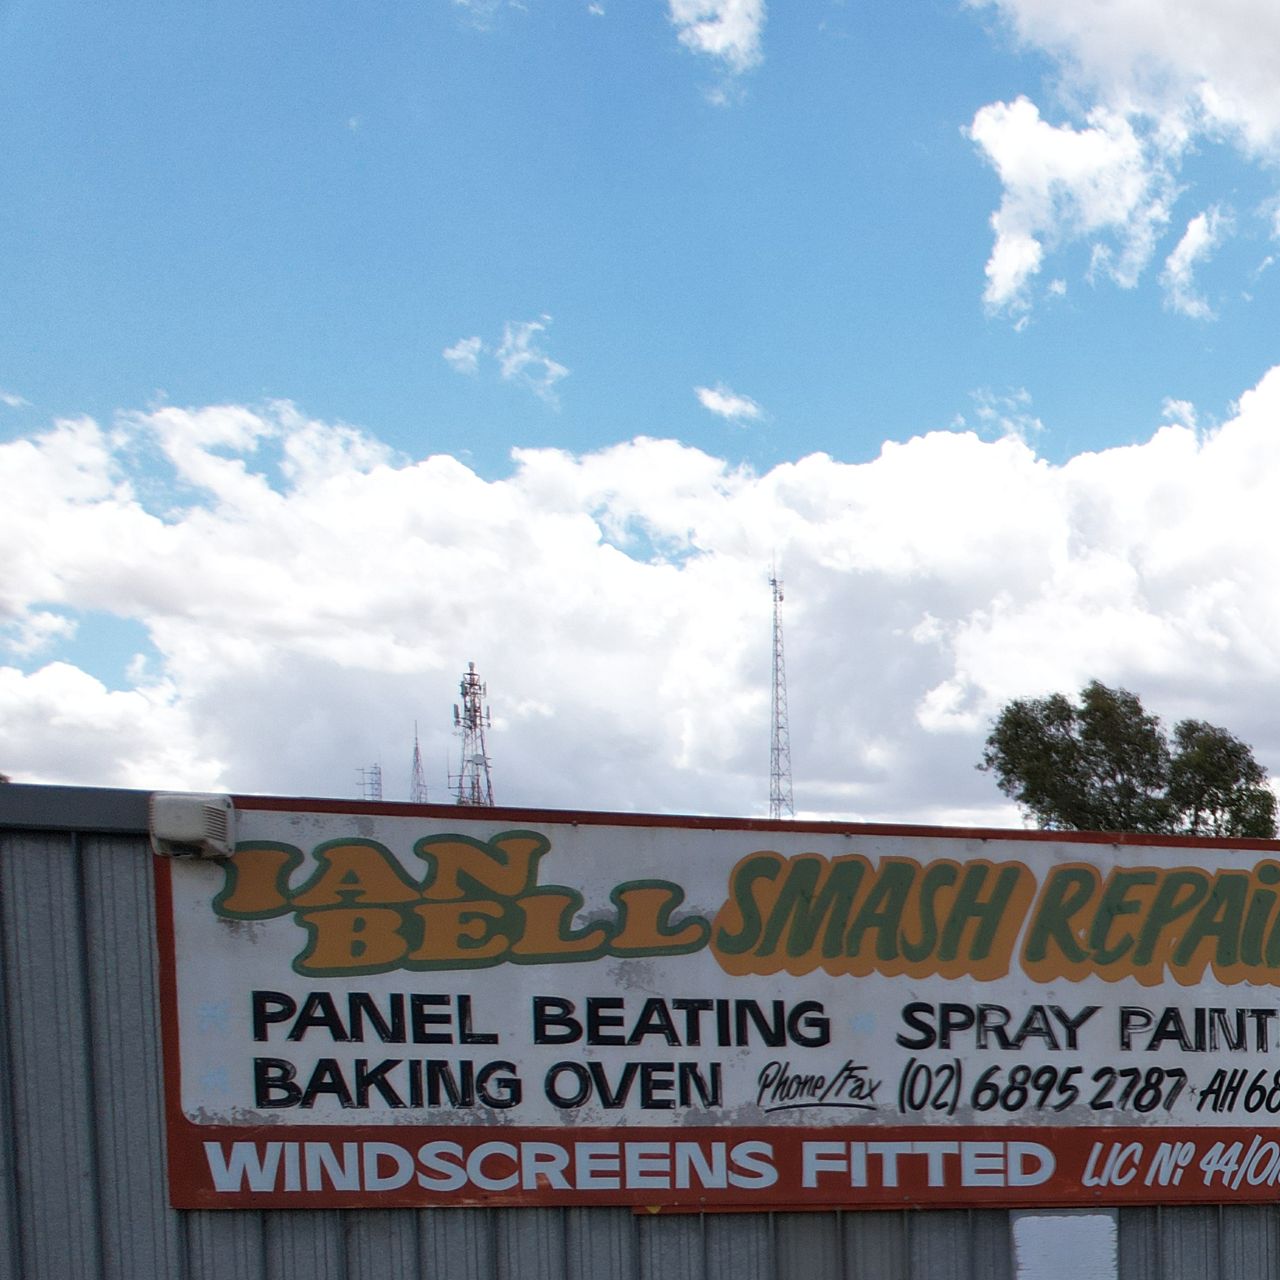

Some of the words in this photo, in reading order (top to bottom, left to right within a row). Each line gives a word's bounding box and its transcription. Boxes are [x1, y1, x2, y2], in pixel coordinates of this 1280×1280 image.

[212, 830, 551, 920] IAN
[292, 879, 711, 978] BELL
[709, 850, 1037, 980] SMASH
[252, 990, 498, 1044] PANEL
[532, 995, 831, 1048] BEATING
[896, 1003, 1102, 1051] SPRAY
[253, 1057, 523, 1110] BAKING
[544, 1060, 723, 1110] OVEN
[757, 1059, 882, 1106] Phone/Fax
[898, 1057, 962, 1116] (02)
[970, 1064, 1083, 1112] 6895
[1089, 1066, 1188, 1113] 2787
[1196, 1068, 1249, 1113] AH
[202, 1140, 779, 1193] WINDSCREENS
[801, 1139, 1057, 1189] FITTED
[1081, 1141, 1144, 1188] LIC
